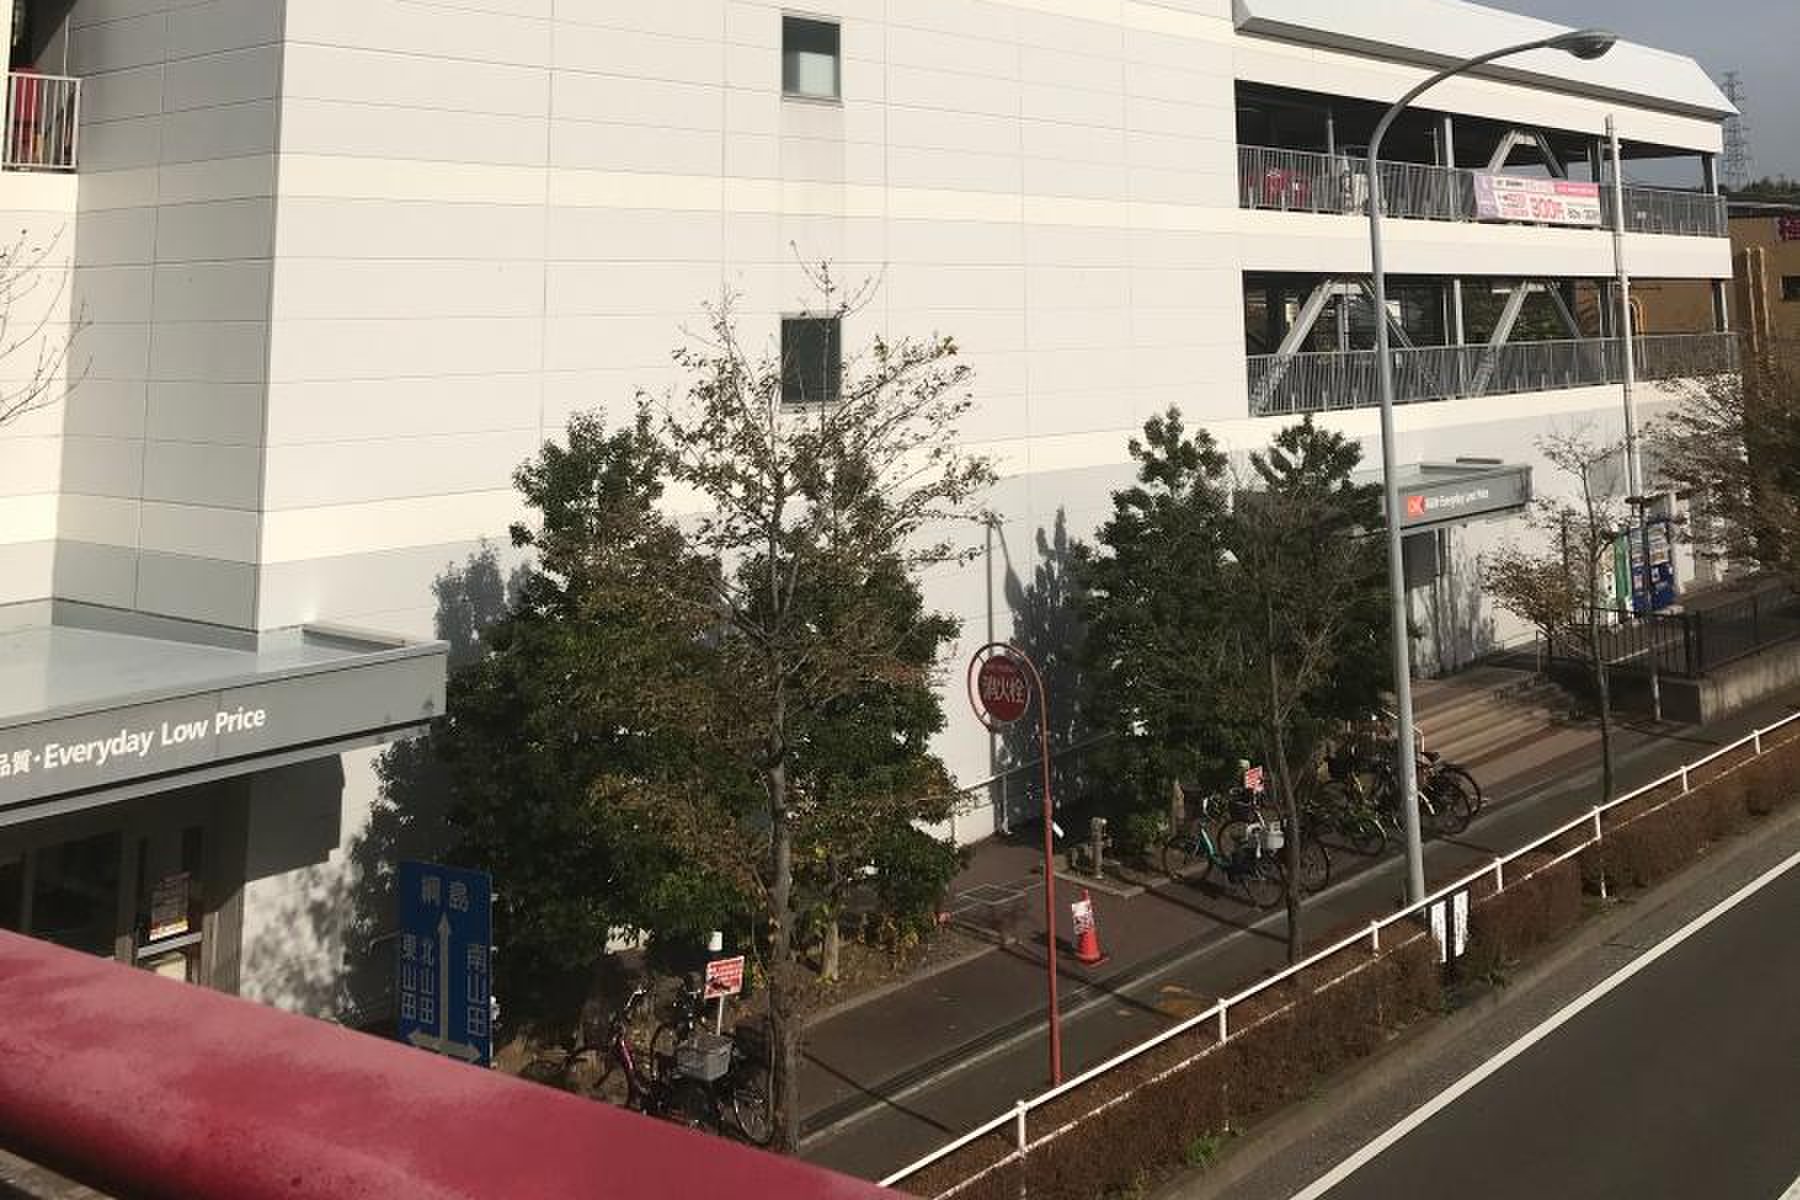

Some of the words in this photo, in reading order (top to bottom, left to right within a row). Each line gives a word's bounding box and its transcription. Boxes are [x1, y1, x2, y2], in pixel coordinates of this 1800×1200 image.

[43, 729, 155, 769] Everyday
[160, 719, 209, 746] Low
[214, 705, 266, 735] Price
